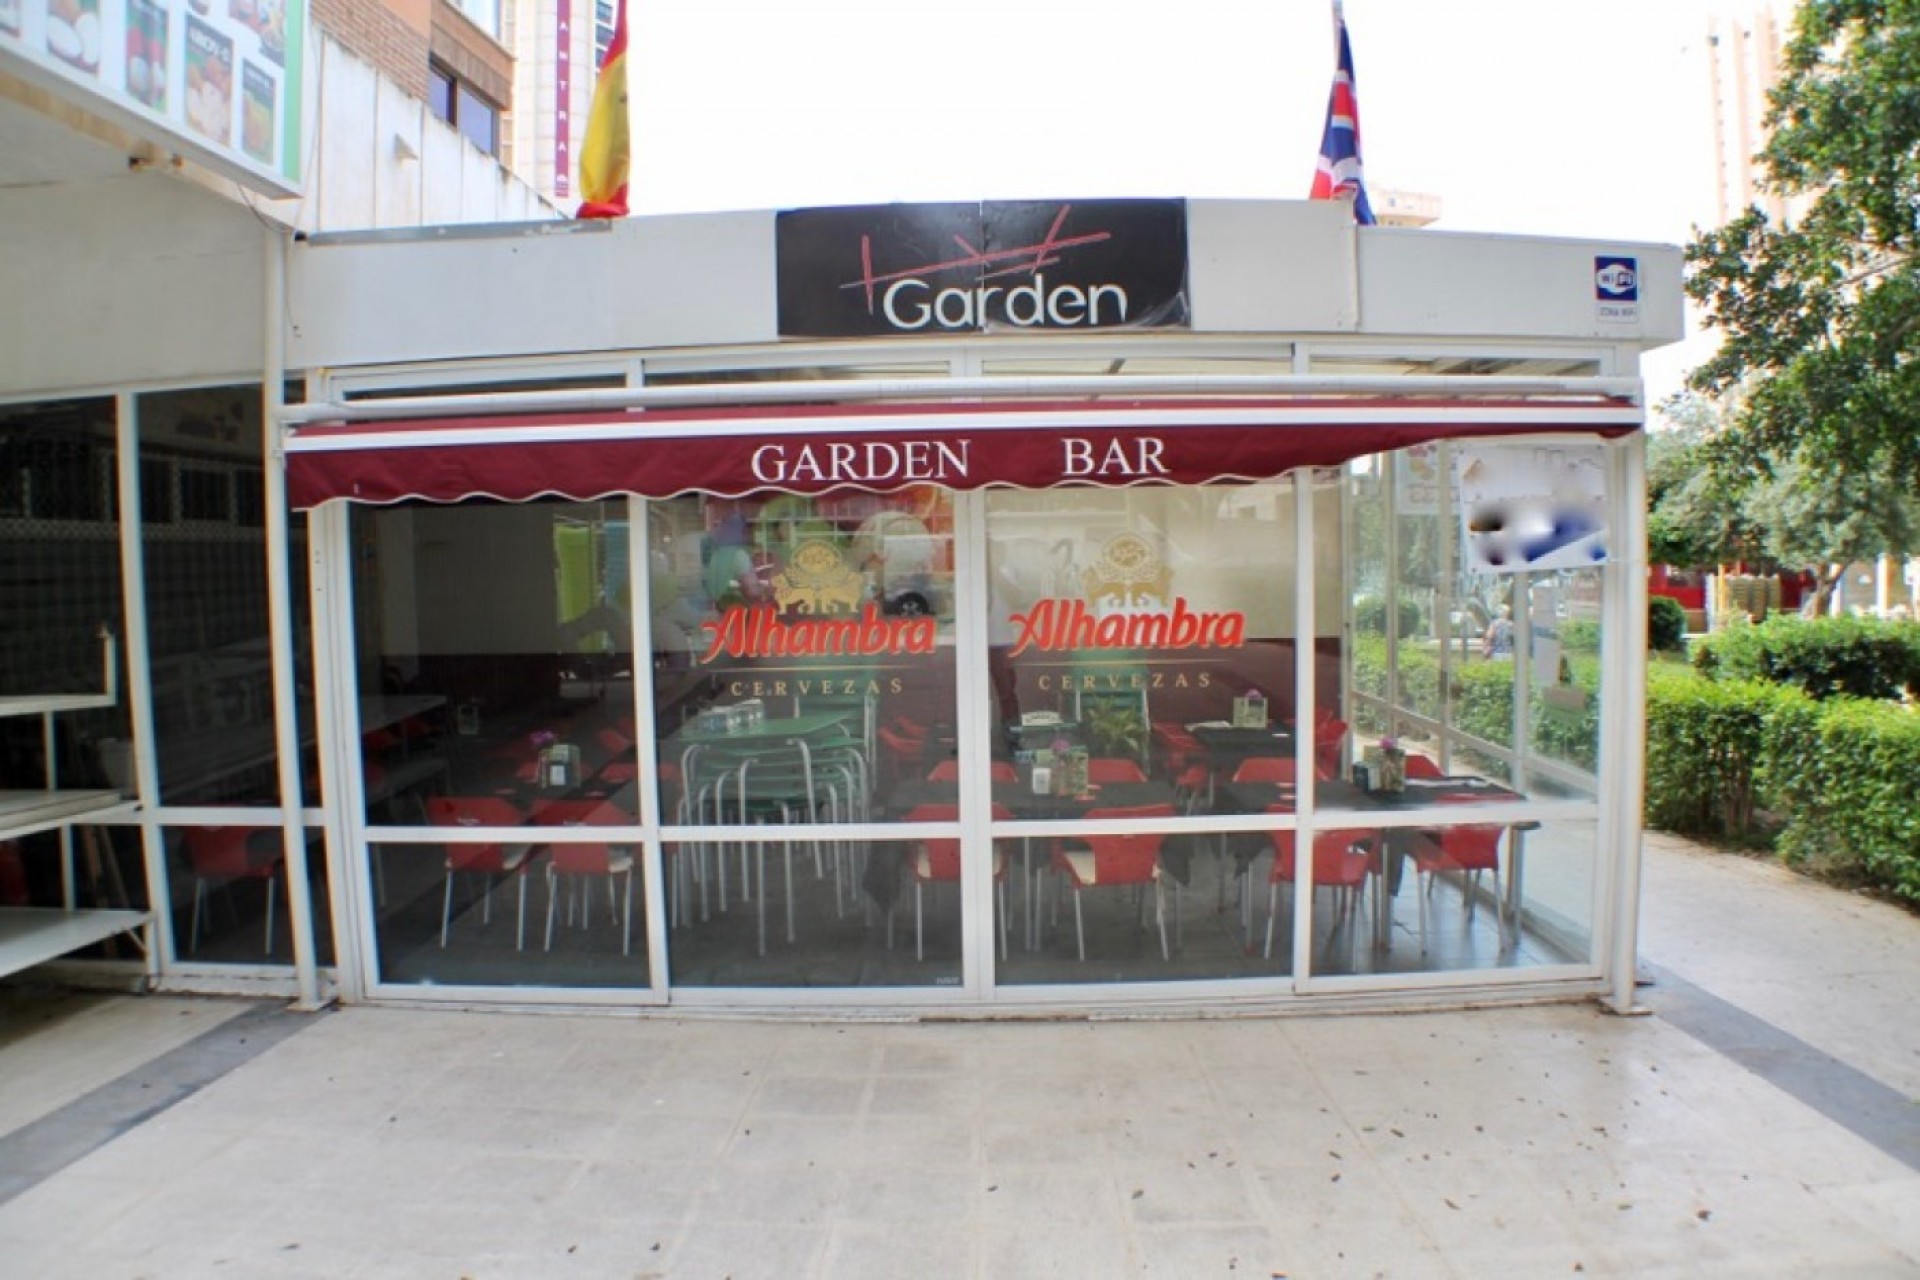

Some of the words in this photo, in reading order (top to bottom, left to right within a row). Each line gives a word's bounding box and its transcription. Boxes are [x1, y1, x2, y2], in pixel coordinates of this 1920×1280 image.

[883, 273, 1128, 329] Garden
[751, 439, 970, 482] GARDEN
[1061, 436, 1171, 477] BAR
[699, 601, 937, 664] Alhambra
[1007, 597, 1246, 658] Alhambra
[730, 678, 903, 697] CERVEZAS
[1038, 672, 1211, 690] CERVEZAS
